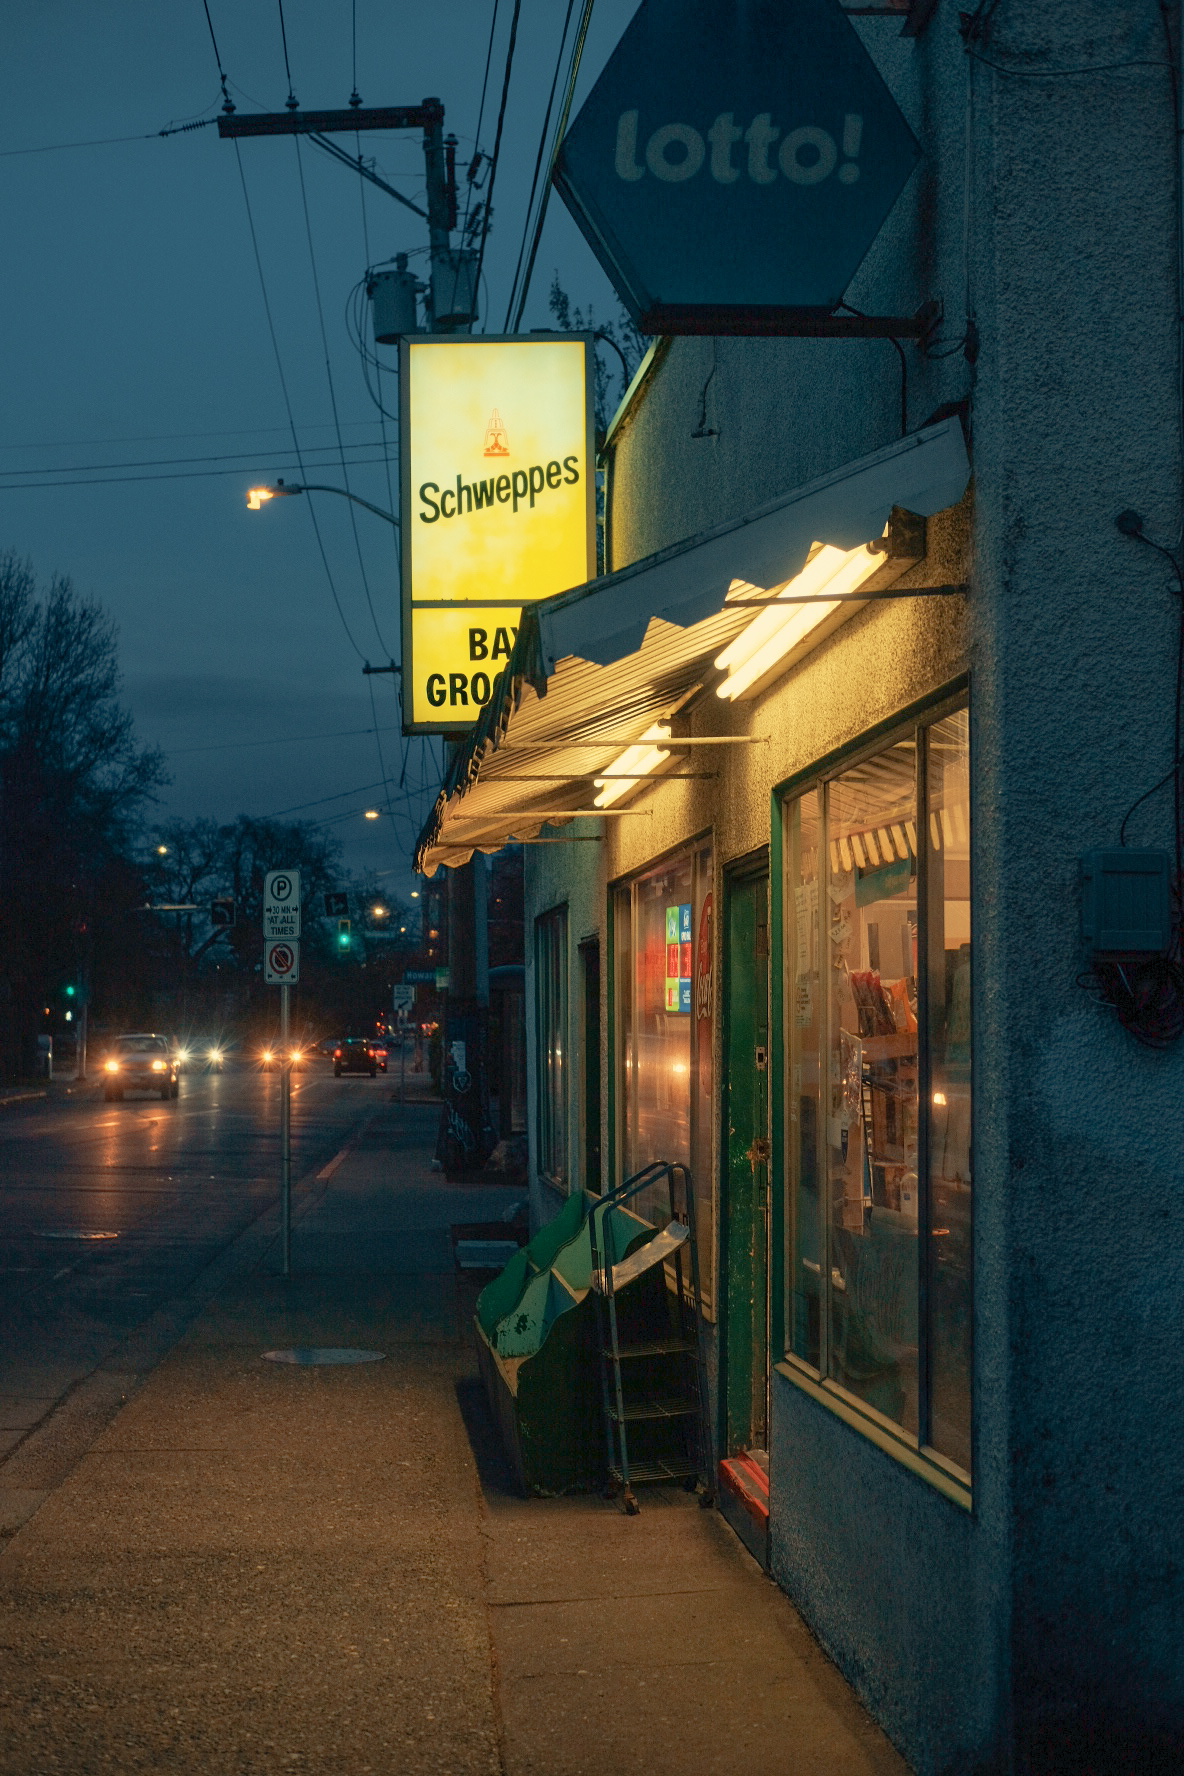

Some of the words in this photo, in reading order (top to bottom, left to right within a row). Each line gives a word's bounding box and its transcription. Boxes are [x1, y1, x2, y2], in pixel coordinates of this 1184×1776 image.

[614, 109, 863, 185] lotto!
[419, 456, 579, 523] Schweppes
[469, 627, 517, 661] BA
[270, 916, 279, 924] AT
[280, 915, 295, 924] ALL
[272, 905, 280, 915] 30
[271, 927, 294, 935] TIMES
